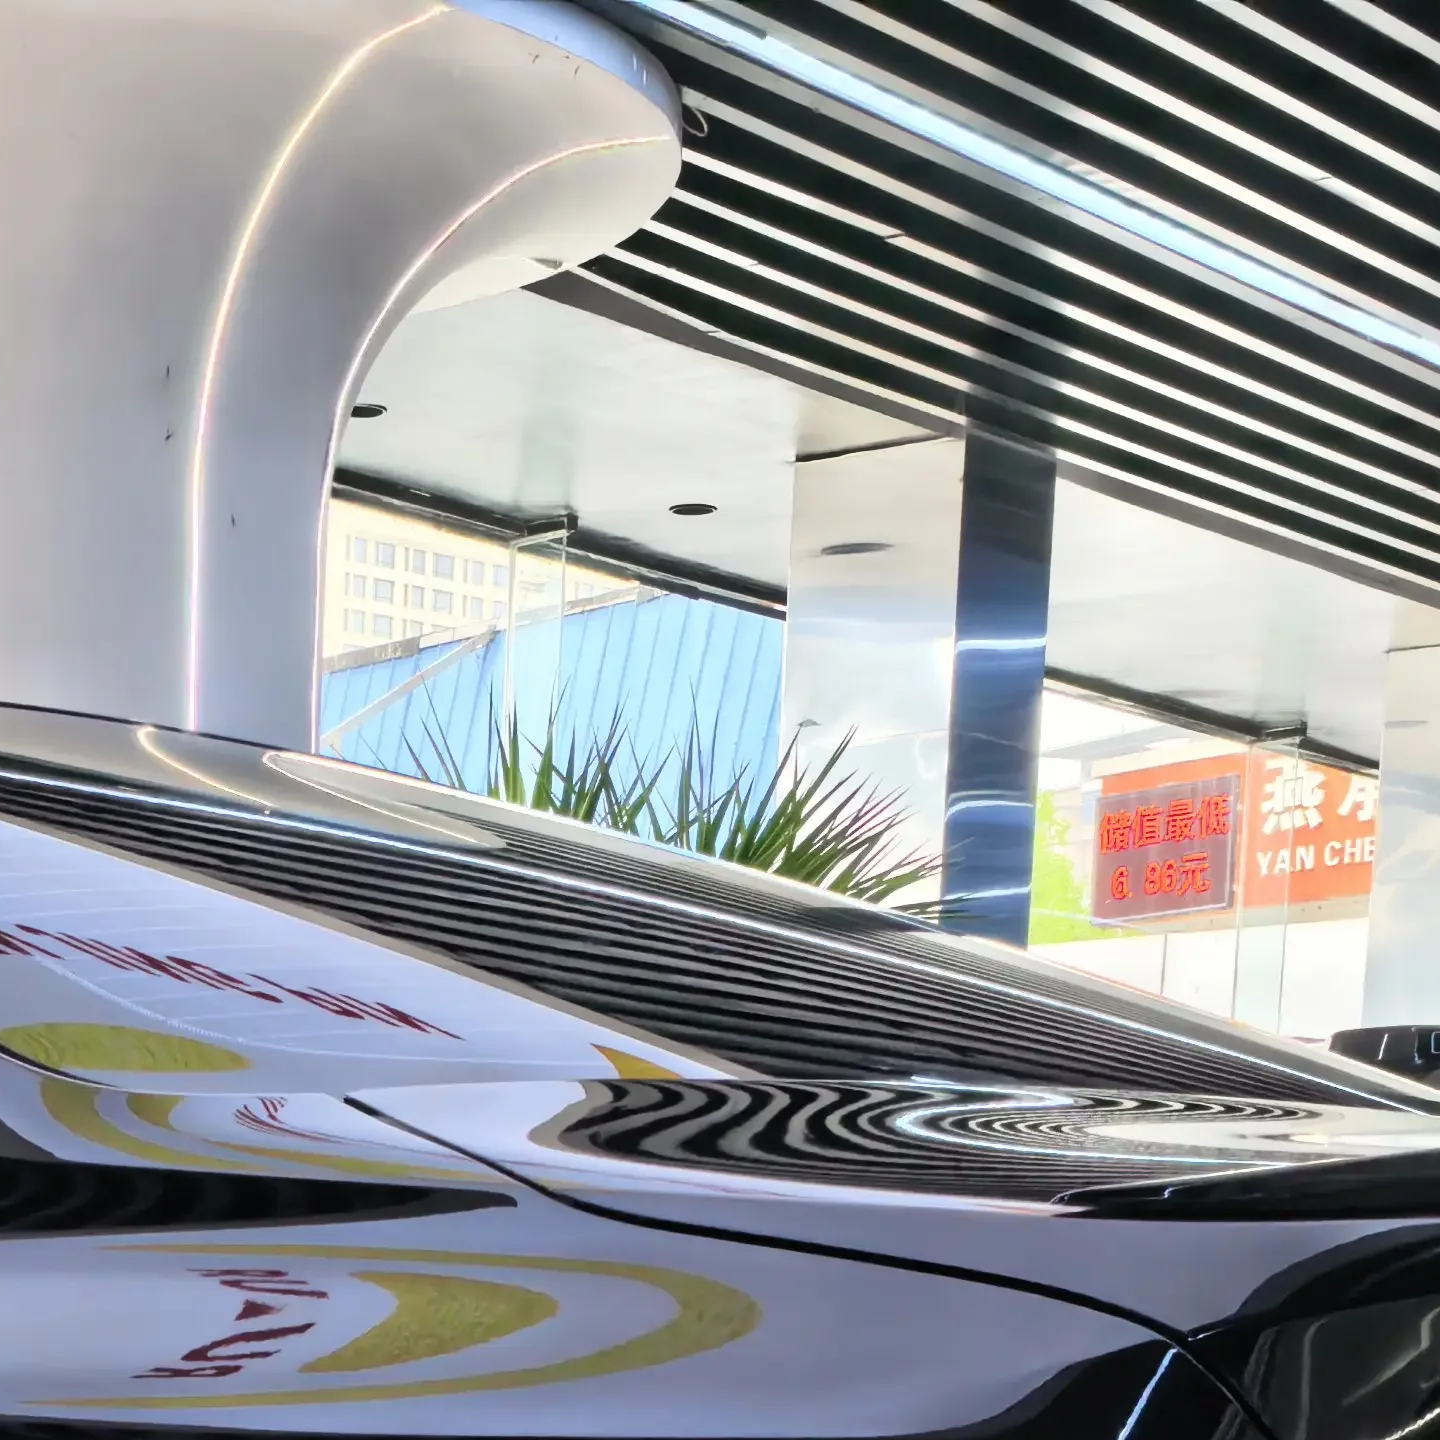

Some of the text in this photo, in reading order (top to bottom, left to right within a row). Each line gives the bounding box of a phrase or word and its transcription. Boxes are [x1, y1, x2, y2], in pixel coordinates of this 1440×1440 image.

[1099, 791, 1234, 856] 储值最低
[1255, 843, 1316, 877] YAN
